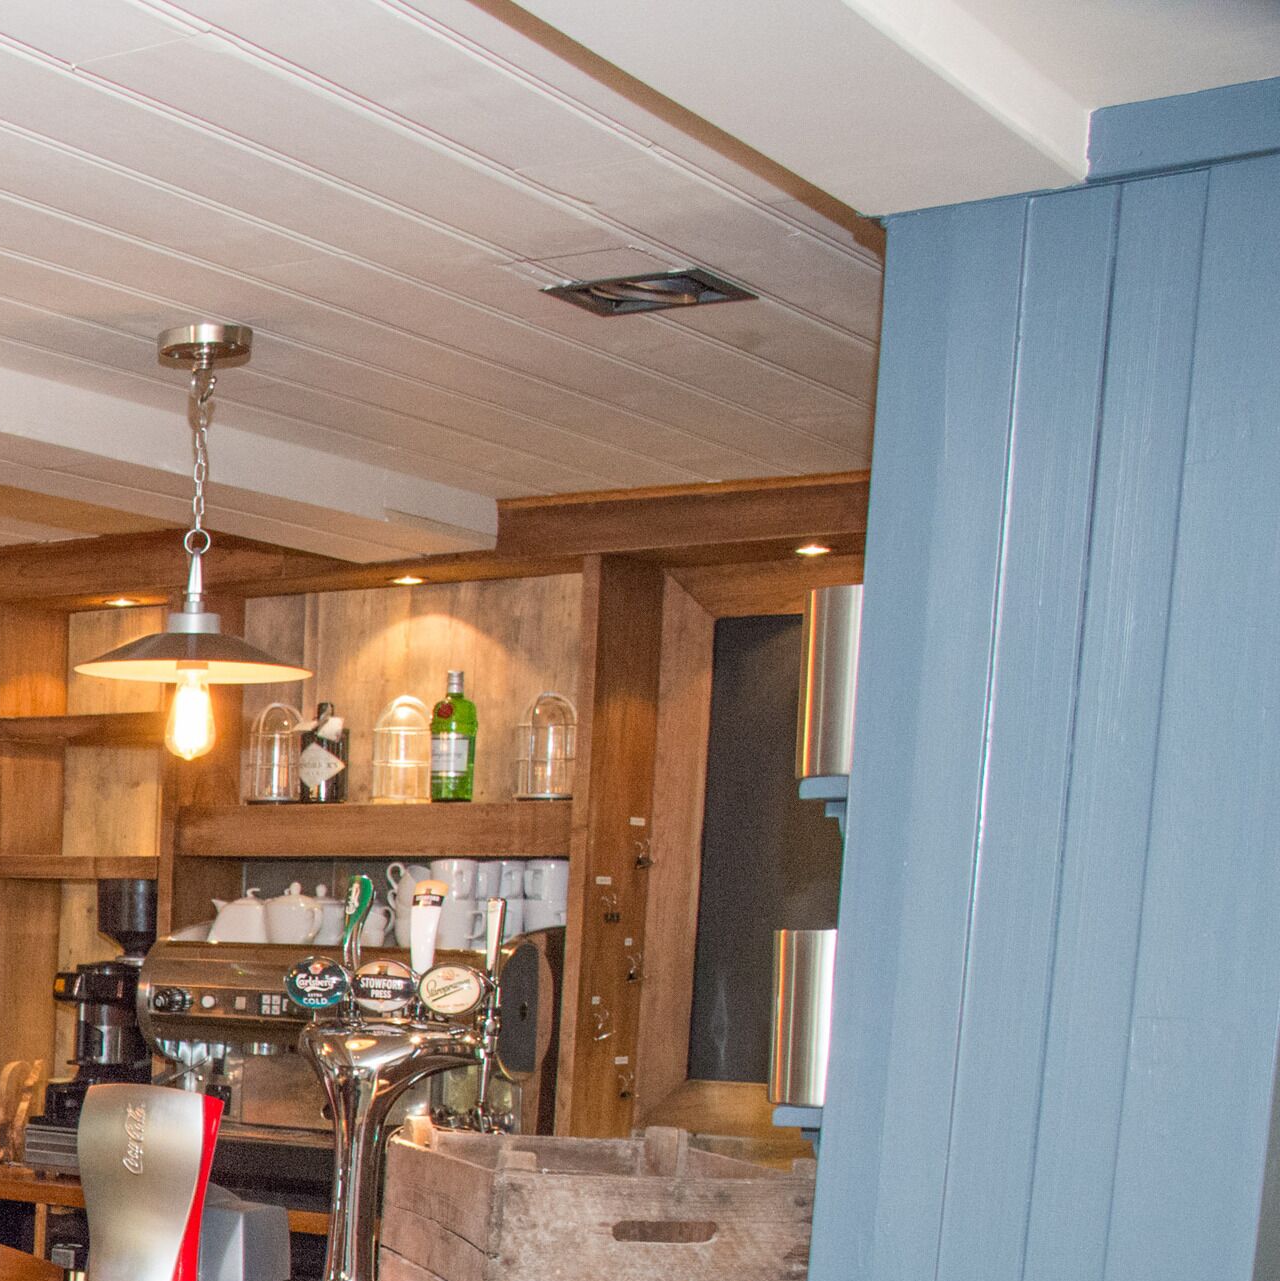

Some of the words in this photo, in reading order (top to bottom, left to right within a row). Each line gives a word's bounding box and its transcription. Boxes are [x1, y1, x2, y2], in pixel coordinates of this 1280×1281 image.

[296, 973, 337, 992] Carlsberg
[360, 977, 404, 990] STOWFORD
[370, 989, 392, 999] PRESS
[302, 997, 328, 1005] COLD
